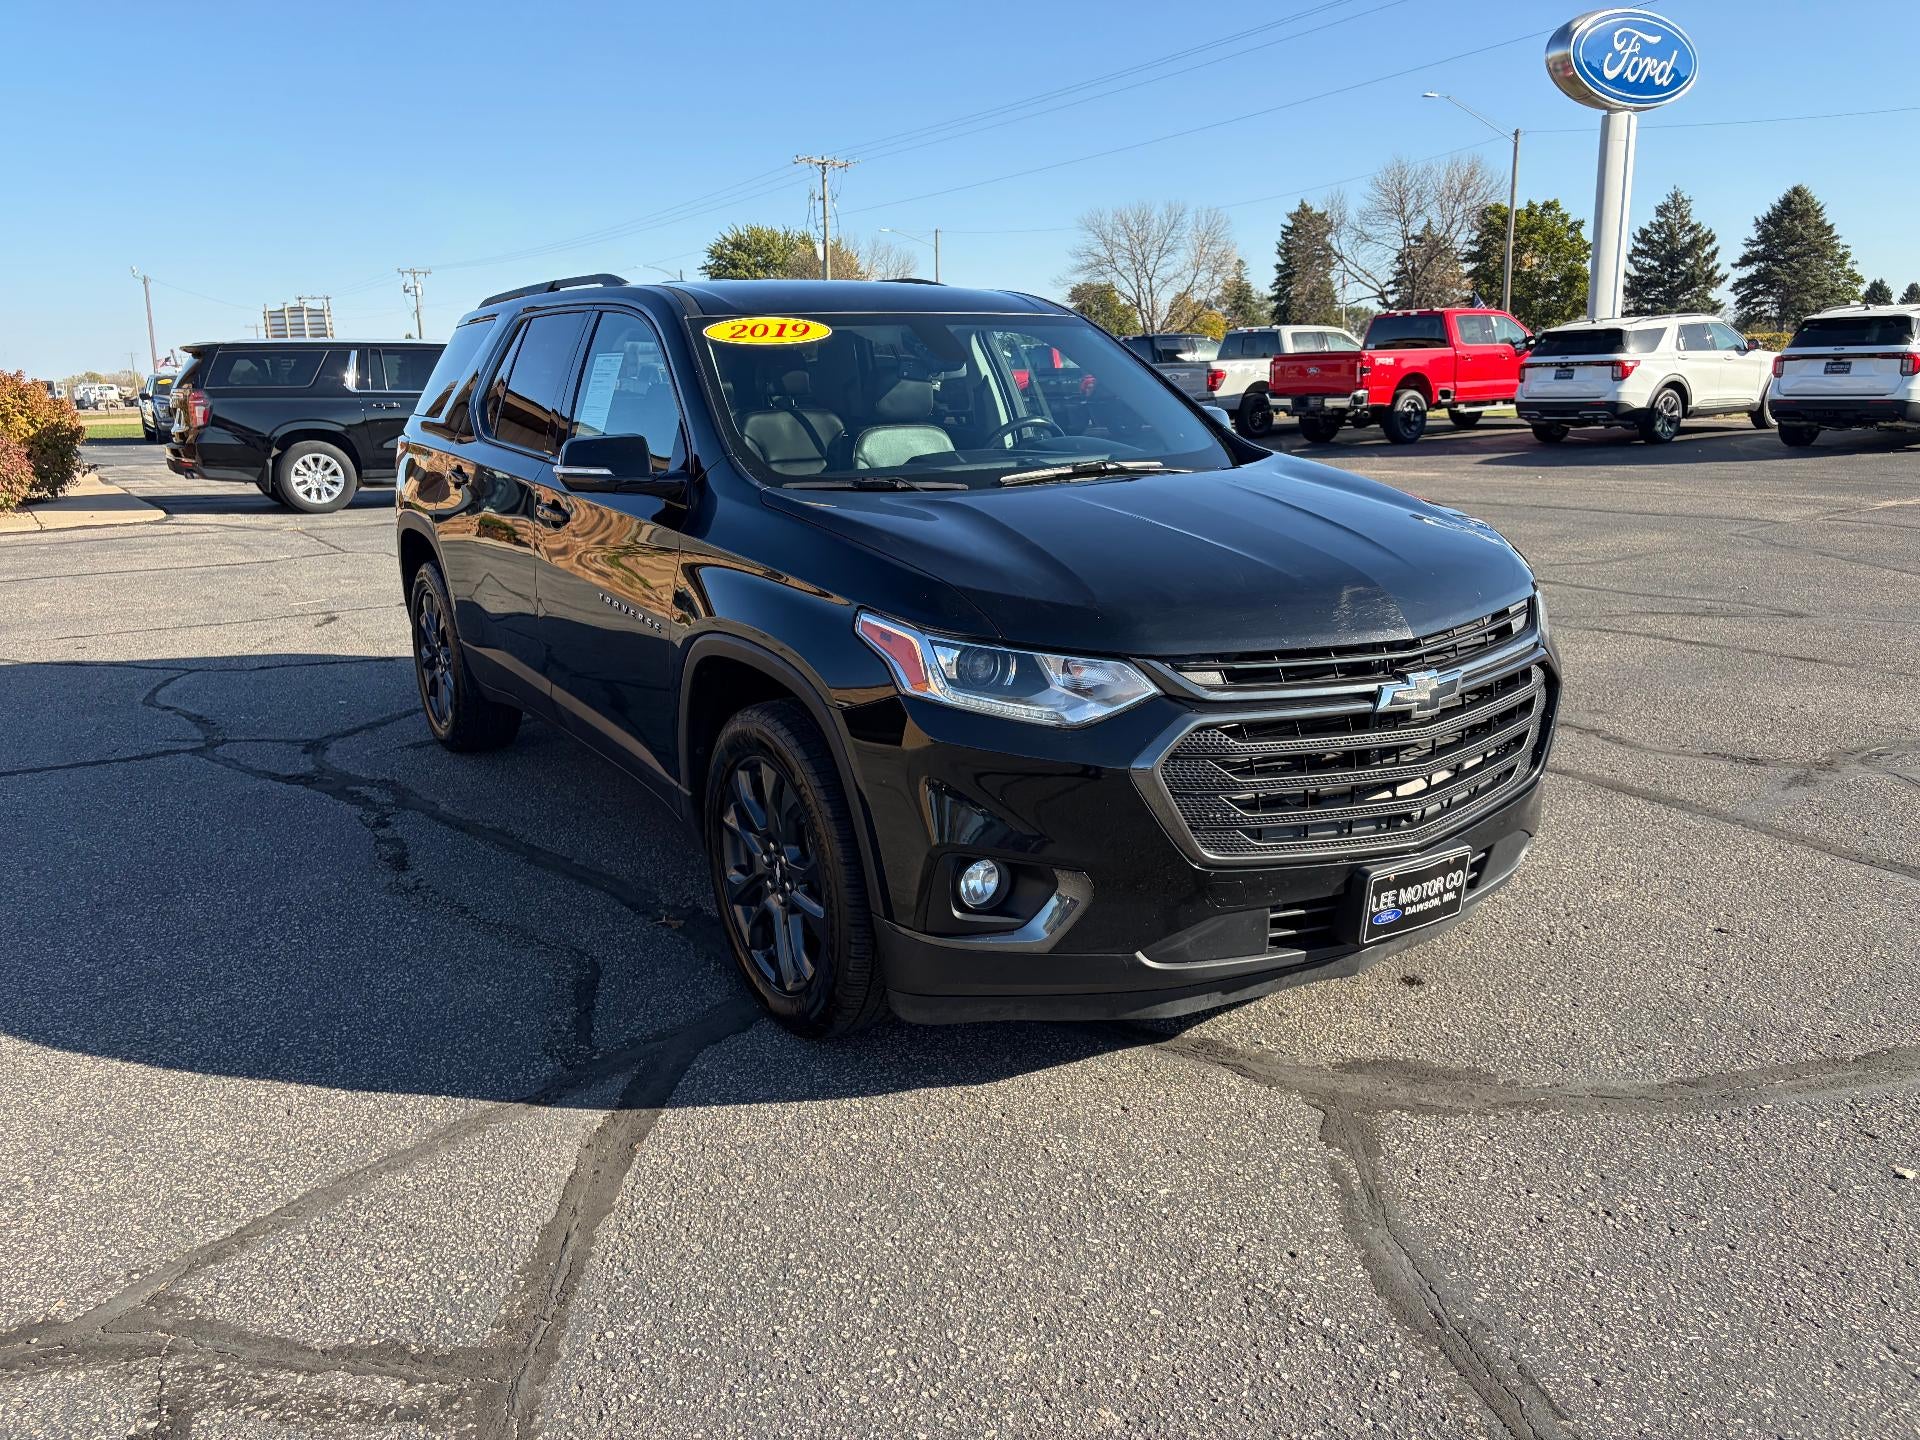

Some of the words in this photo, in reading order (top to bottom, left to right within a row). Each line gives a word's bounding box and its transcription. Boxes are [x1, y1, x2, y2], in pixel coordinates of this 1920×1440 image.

[1603, 27, 1678, 87] Ford
[729, 323, 811, 339] 2019
[1371, 889, 1397, 913] LEE
[1398, 876, 1445, 905] MOTOR
[1445, 869, 1464, 889] CO
[1405, 896, 1441, 916] DAWSON,
[1377, 910, 1397, 923] Ford
